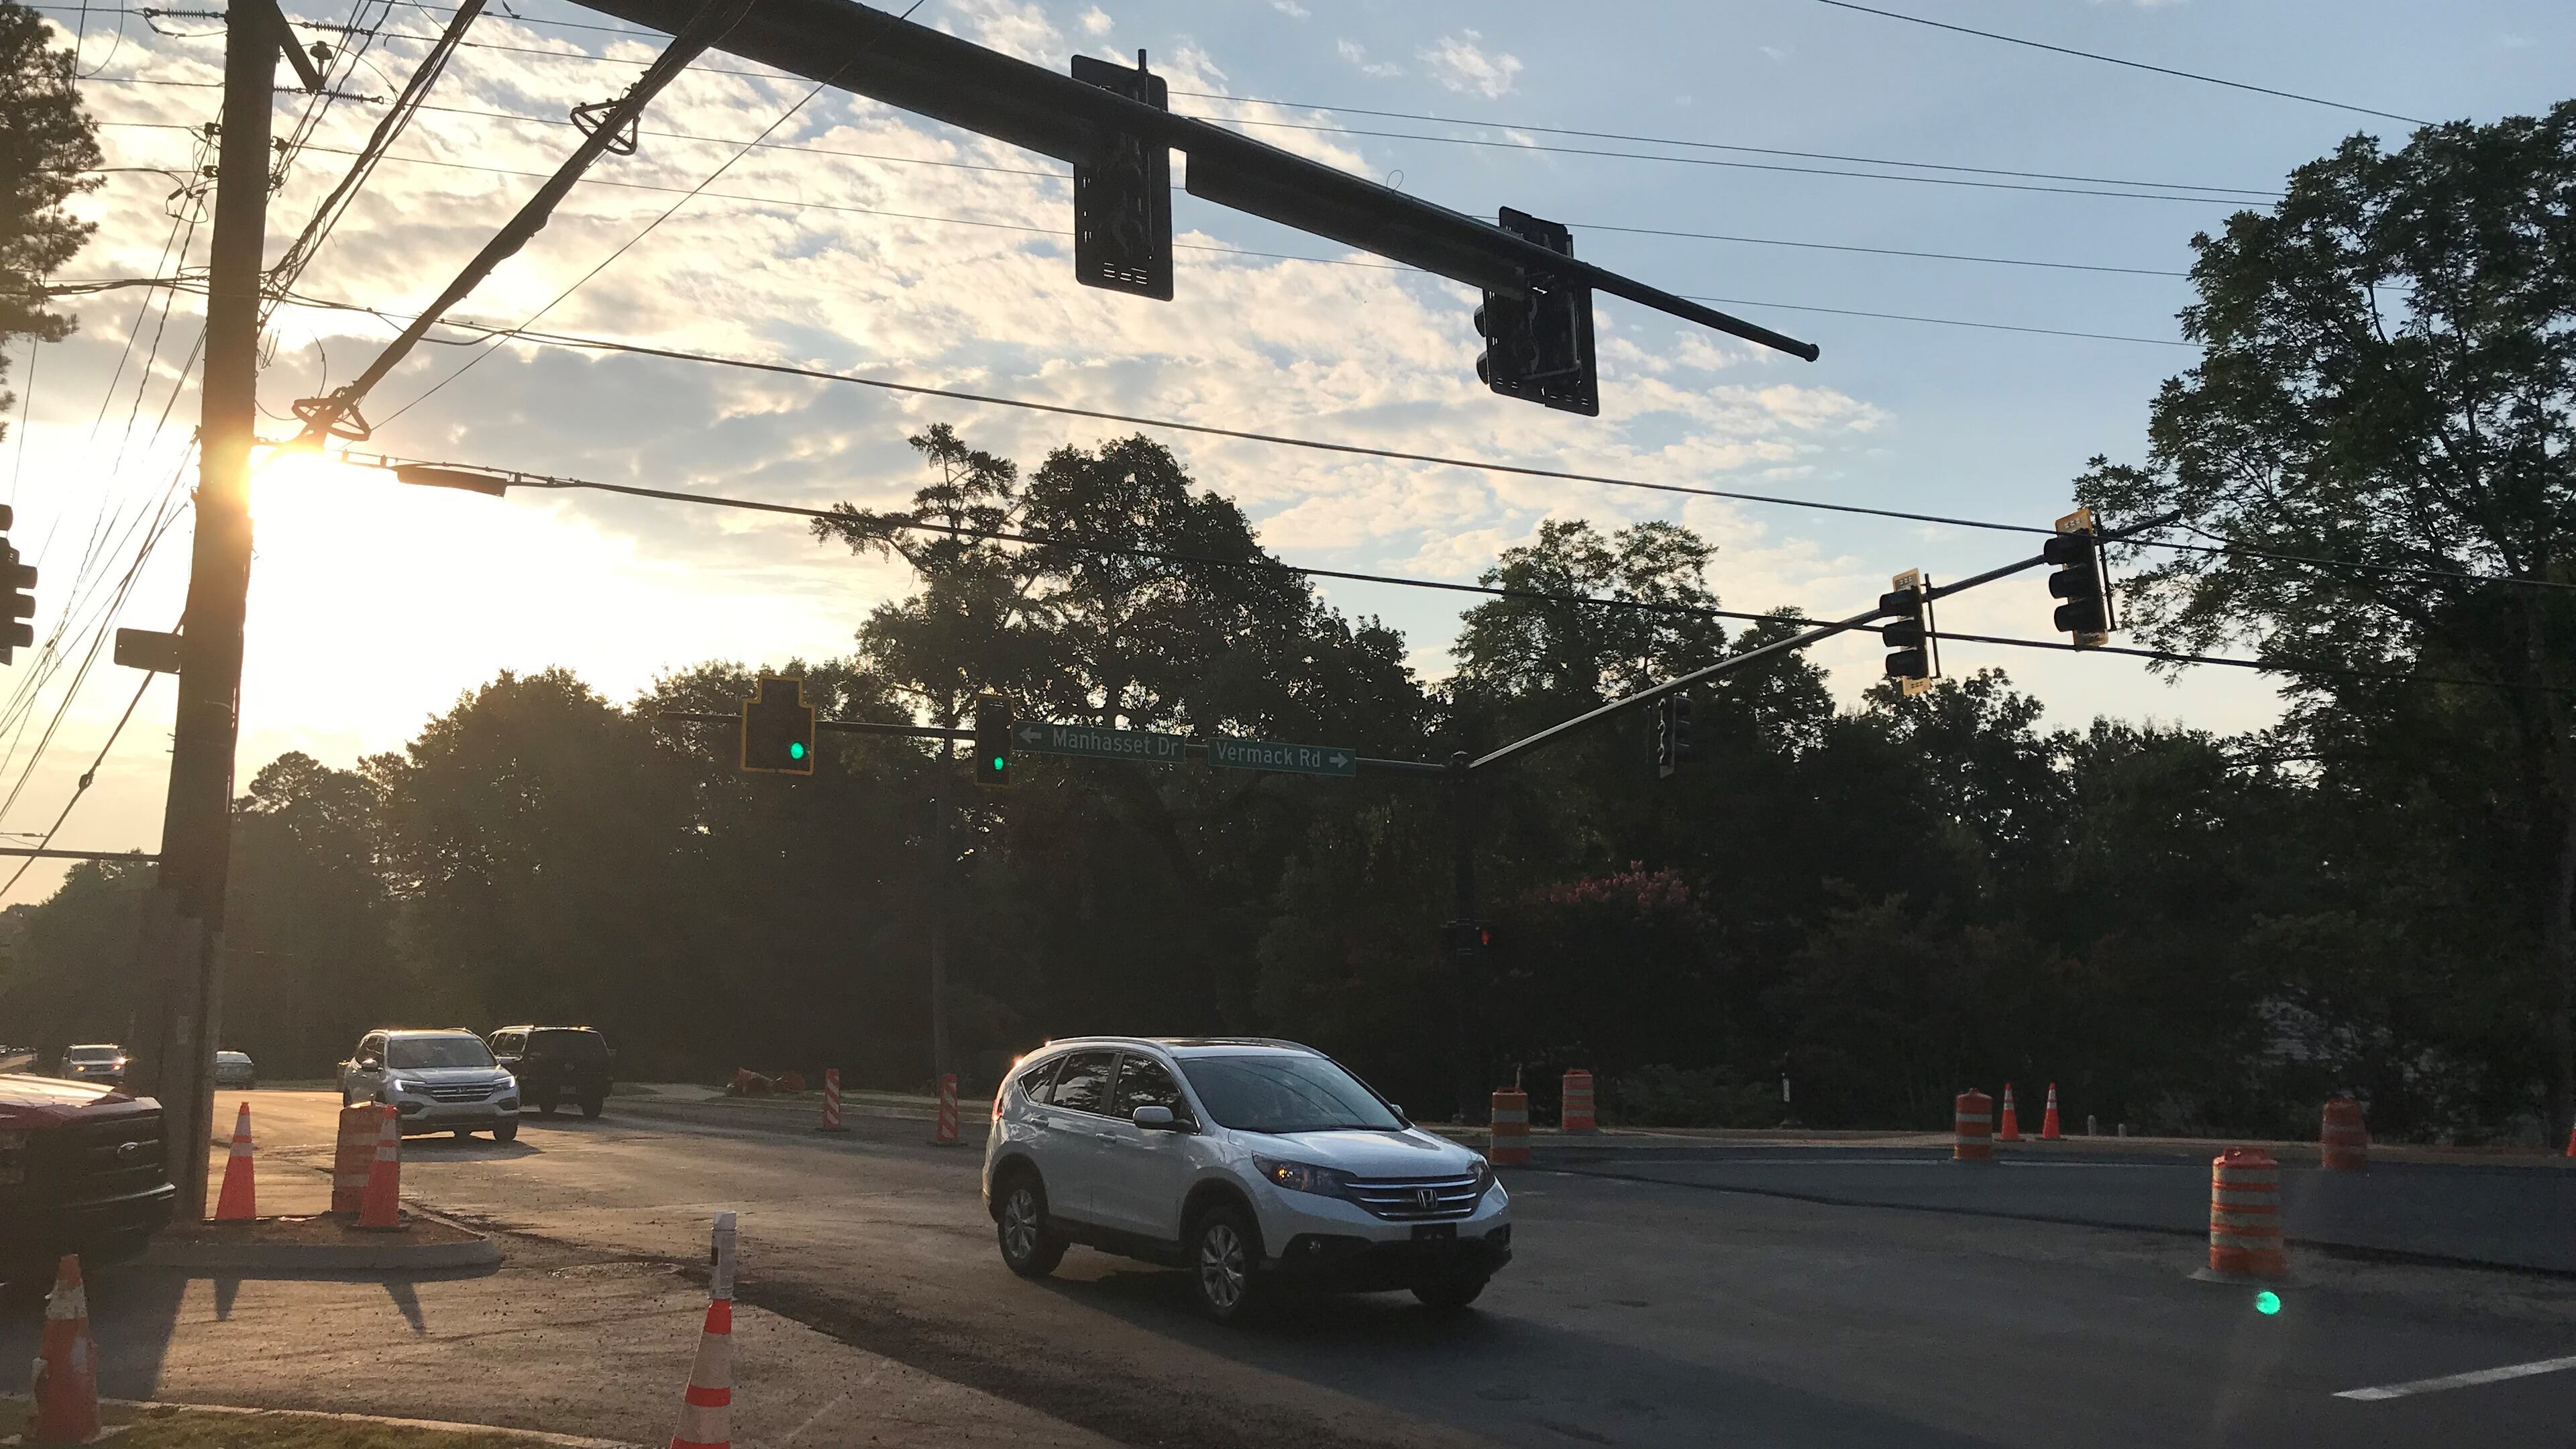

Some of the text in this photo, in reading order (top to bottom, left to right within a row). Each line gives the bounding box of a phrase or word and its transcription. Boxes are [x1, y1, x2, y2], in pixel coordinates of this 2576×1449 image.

[1053, 728, 1179, 756] Manhasset Dr
[1216, 741, 1320, 767] Vermack Rd
